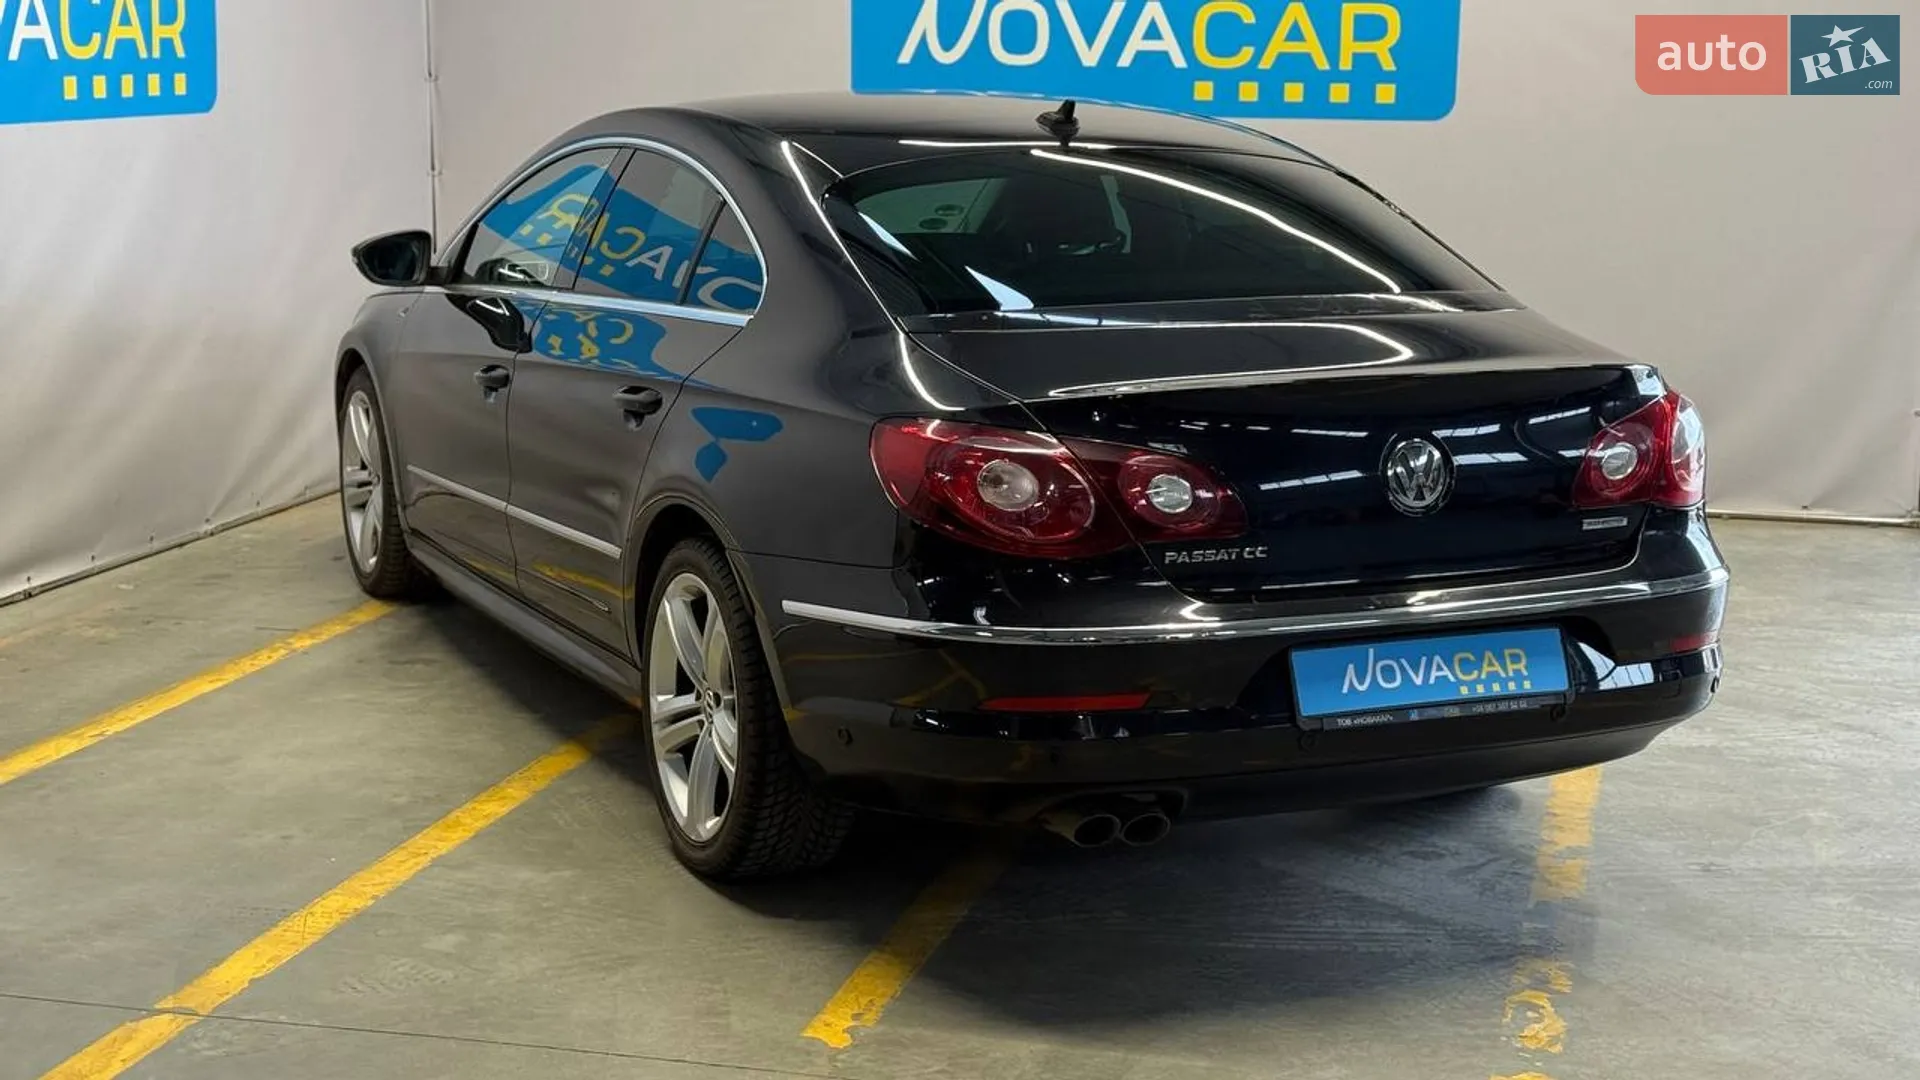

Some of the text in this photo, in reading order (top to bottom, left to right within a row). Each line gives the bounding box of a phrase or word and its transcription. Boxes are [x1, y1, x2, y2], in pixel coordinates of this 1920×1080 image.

[0, 0, 187, 61] ACAR
[897, 0, 1401, 71] NOVACAR
[1164, 546, 1268, 564] PASSAT CC
[1341, 648, 1528, 694] NOVACAR
